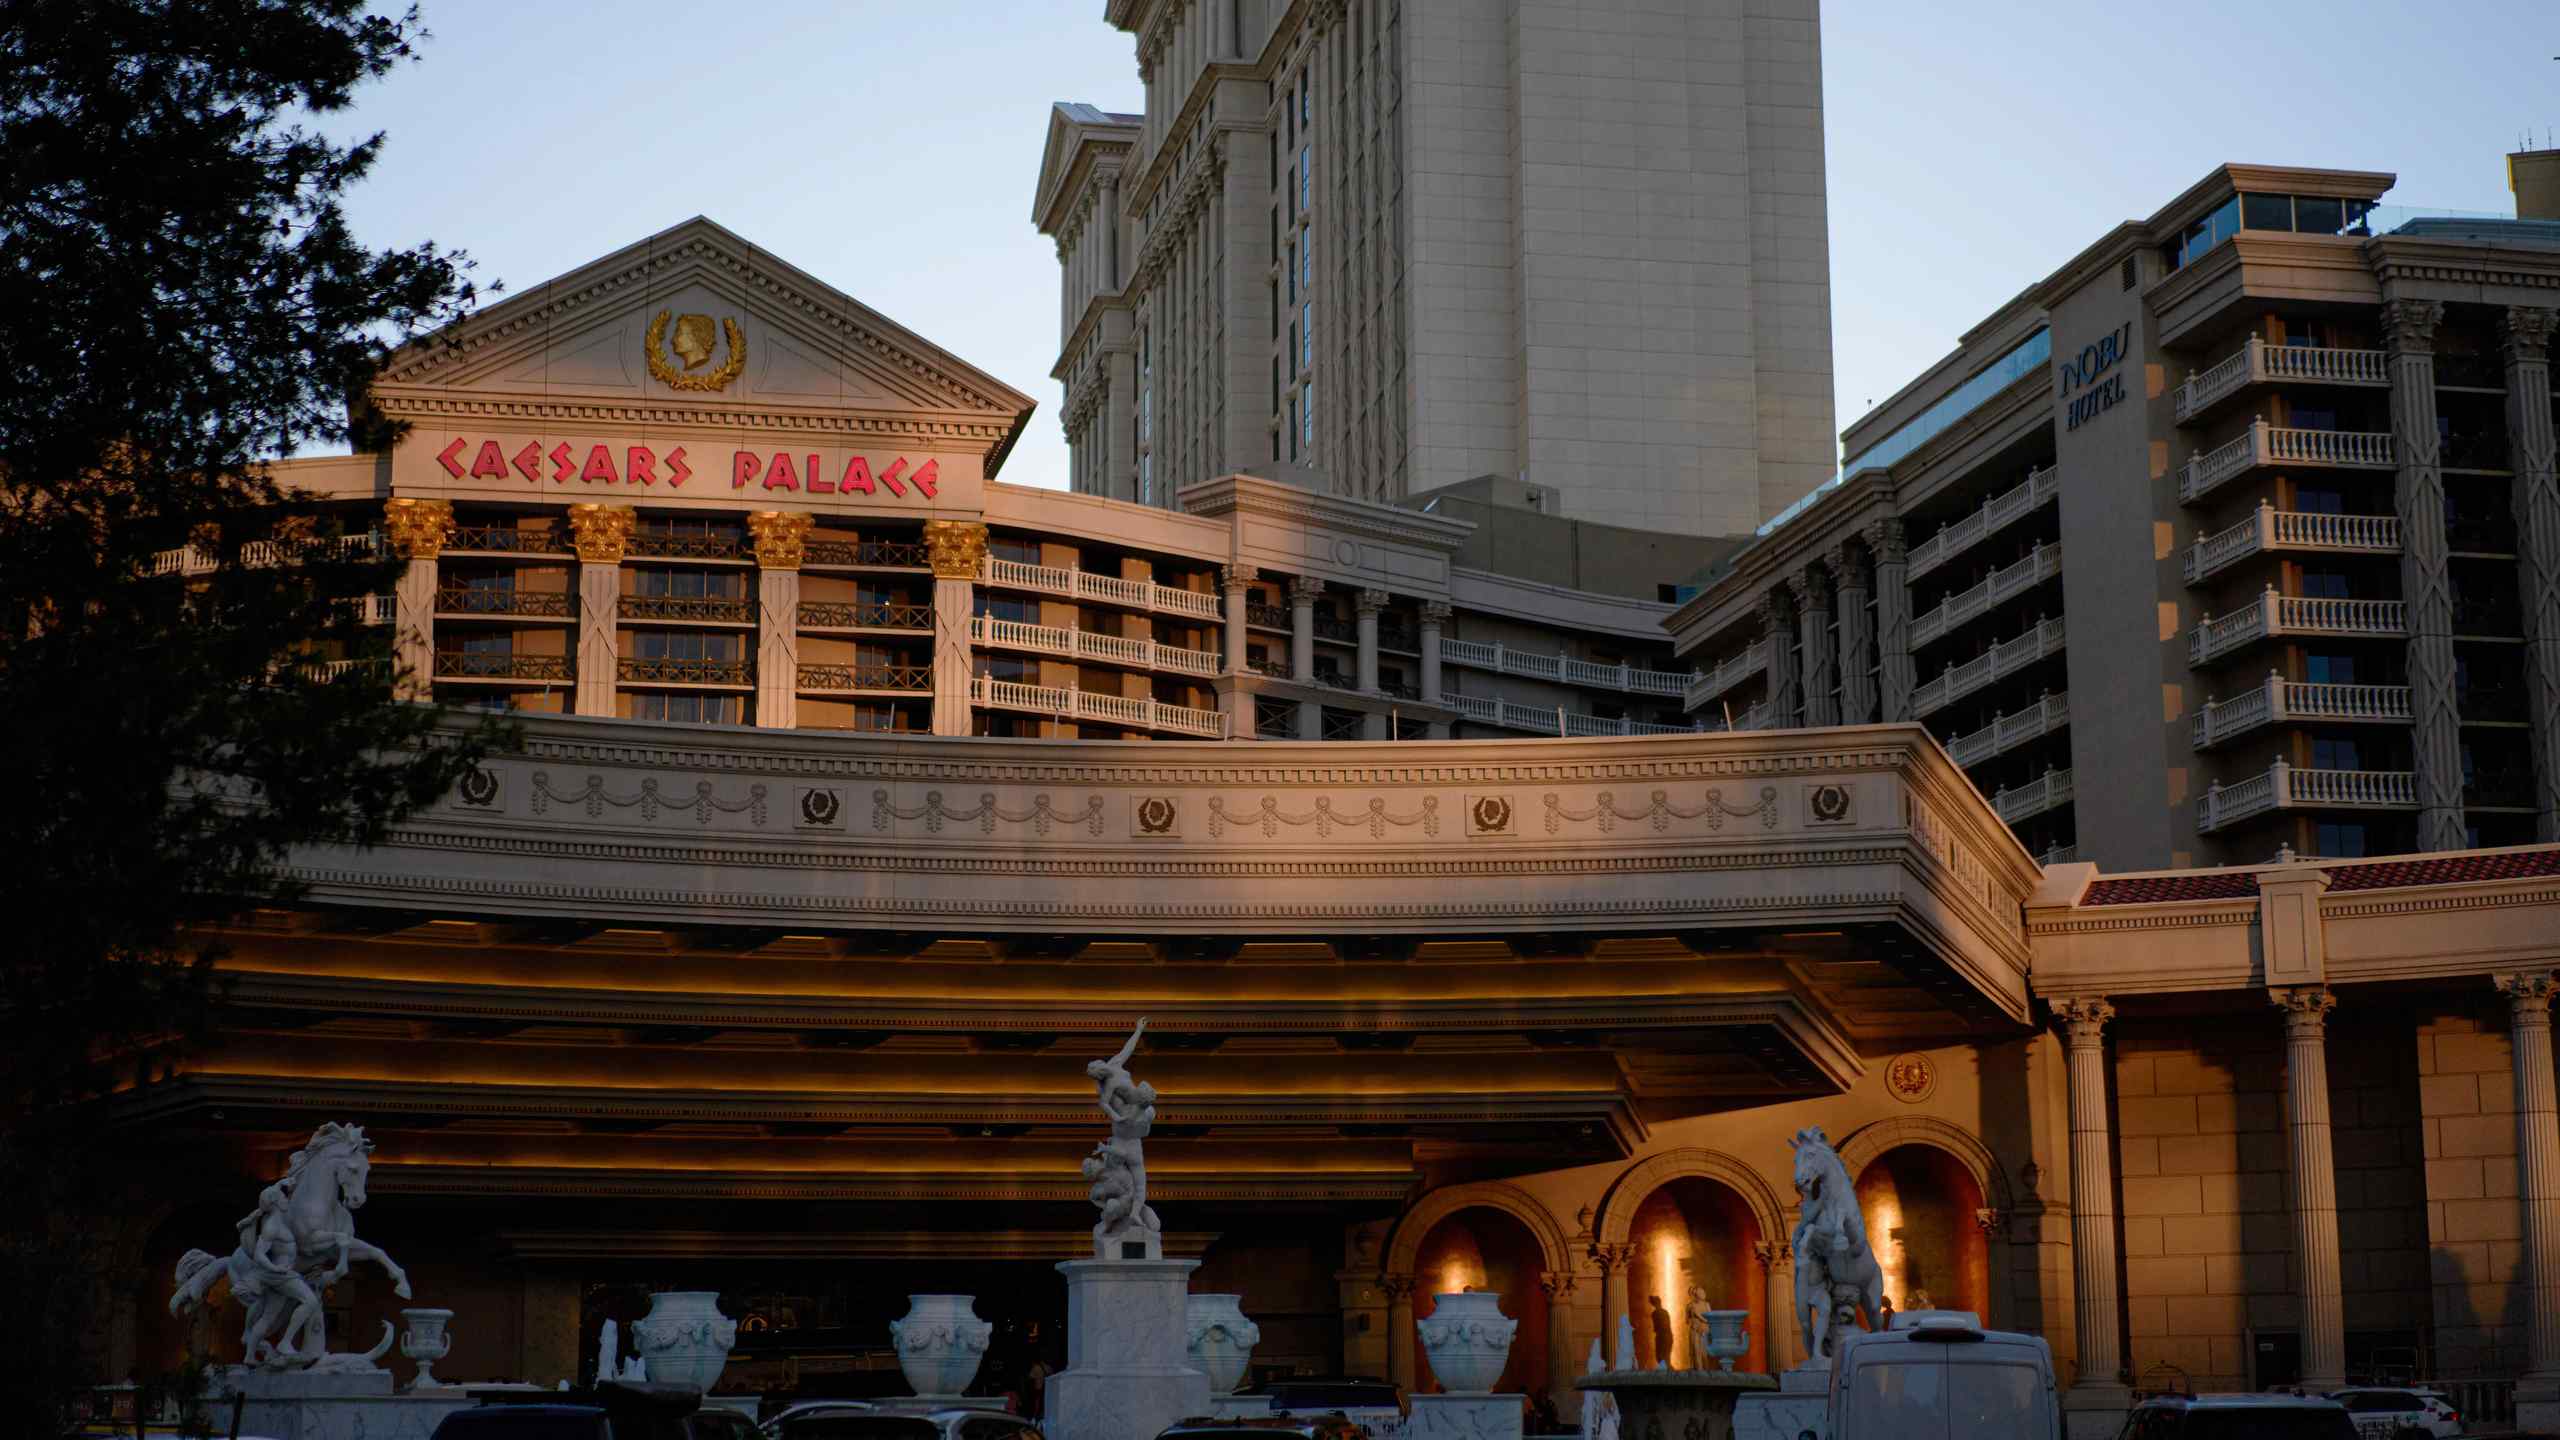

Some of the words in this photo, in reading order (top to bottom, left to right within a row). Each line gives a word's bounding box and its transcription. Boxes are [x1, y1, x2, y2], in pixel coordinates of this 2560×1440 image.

[2059, 320, 2131, 398] NOBU
[2066, 372, 2126, 432] HOTEL
[436, 436, 693, 488] CAESARS
[732, 450, 939, 499] PALACE
